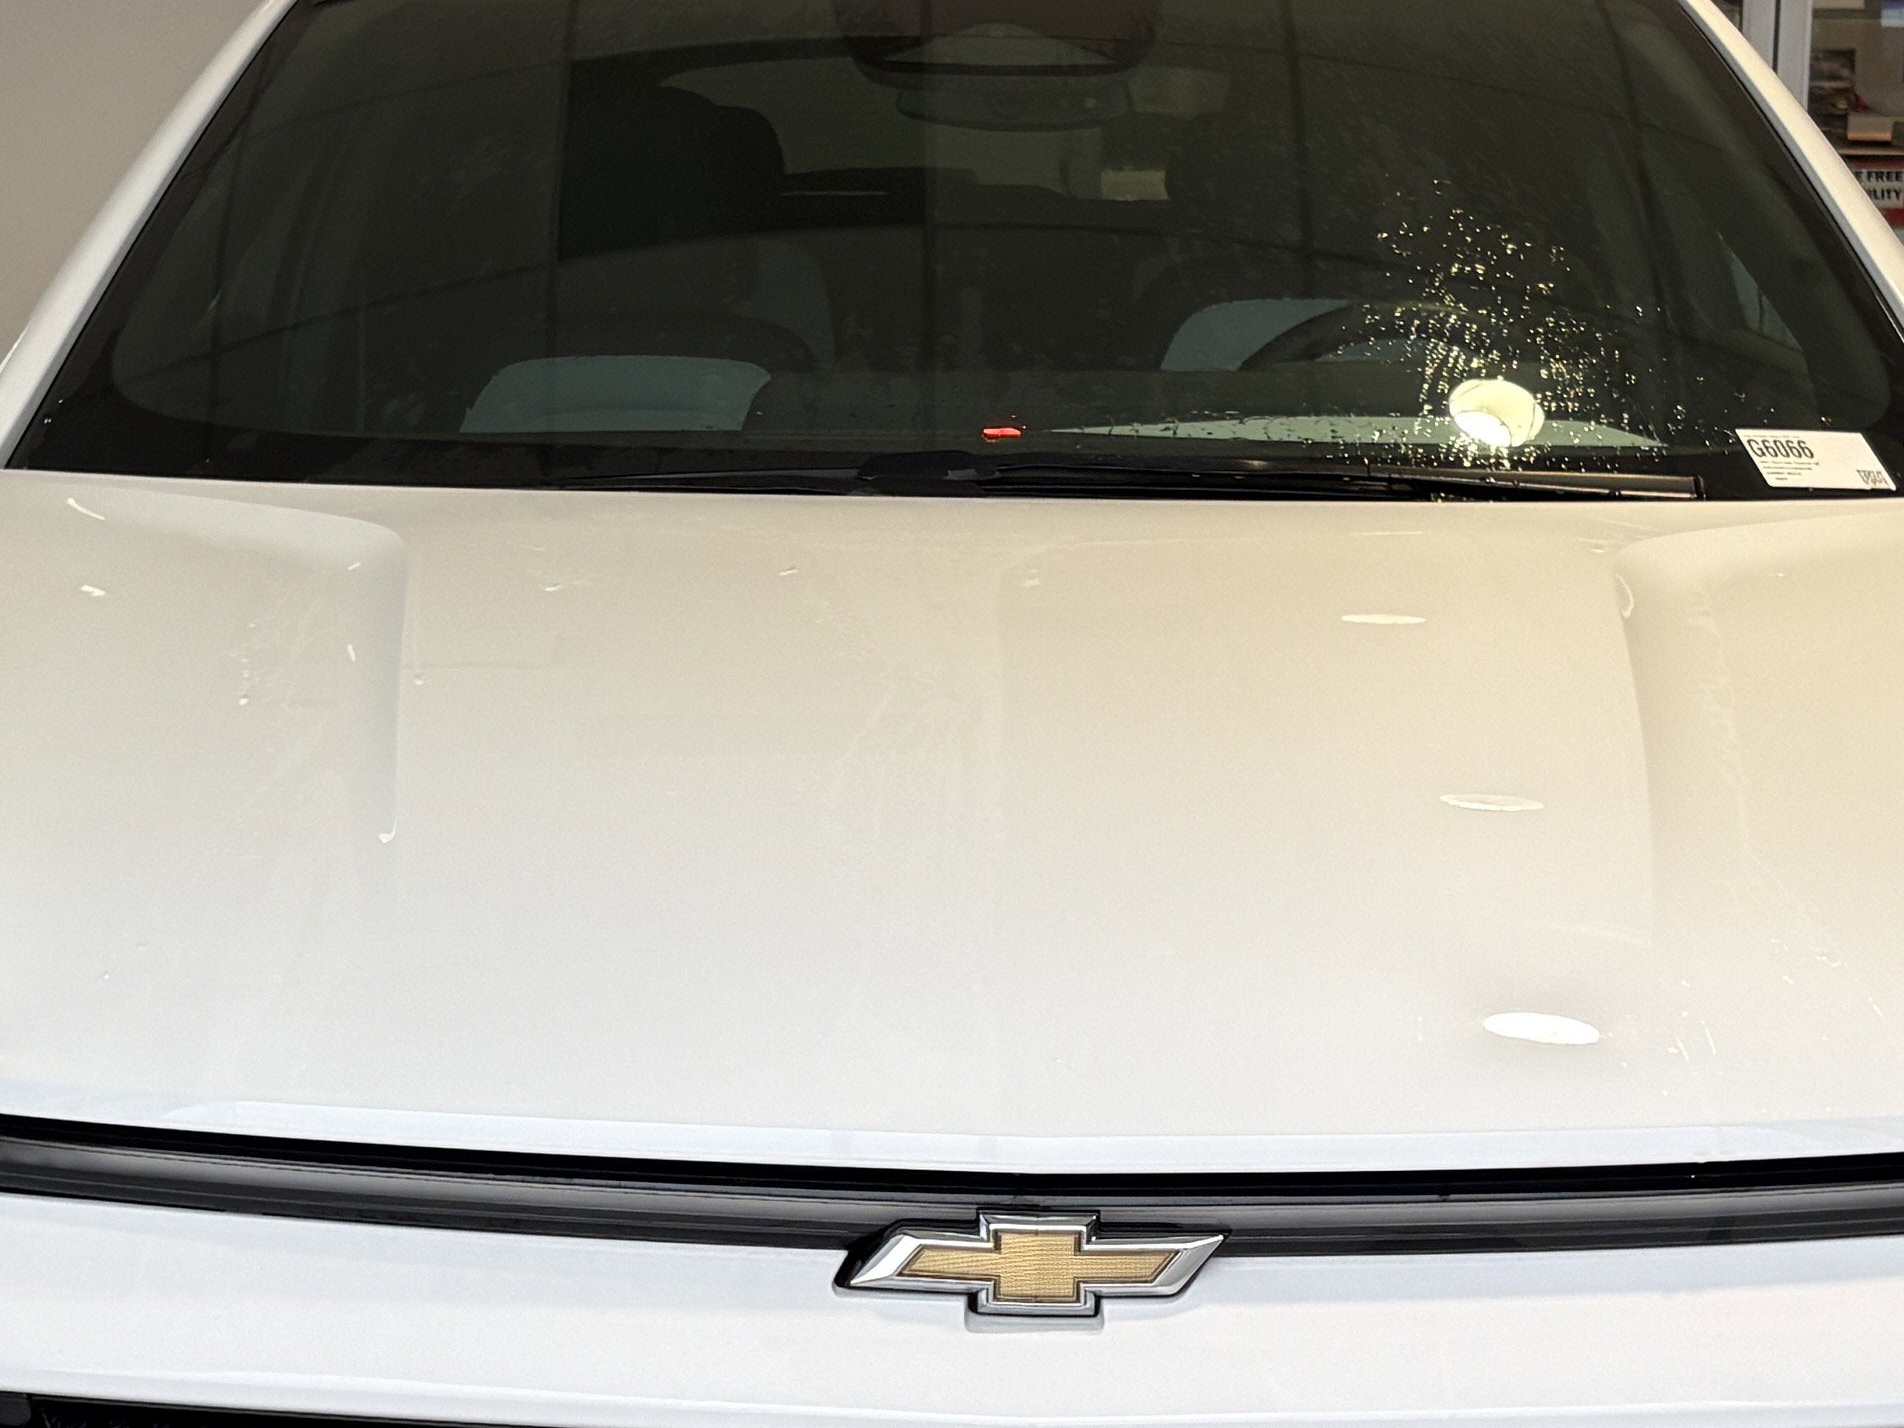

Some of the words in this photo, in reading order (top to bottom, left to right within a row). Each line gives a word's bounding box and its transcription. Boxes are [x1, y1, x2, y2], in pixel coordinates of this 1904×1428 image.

[1867, 170, 1904, 182] FREE
[1867, 188, 1903, 201] ILITY
[1746, 438, 1815, 460] G6066
